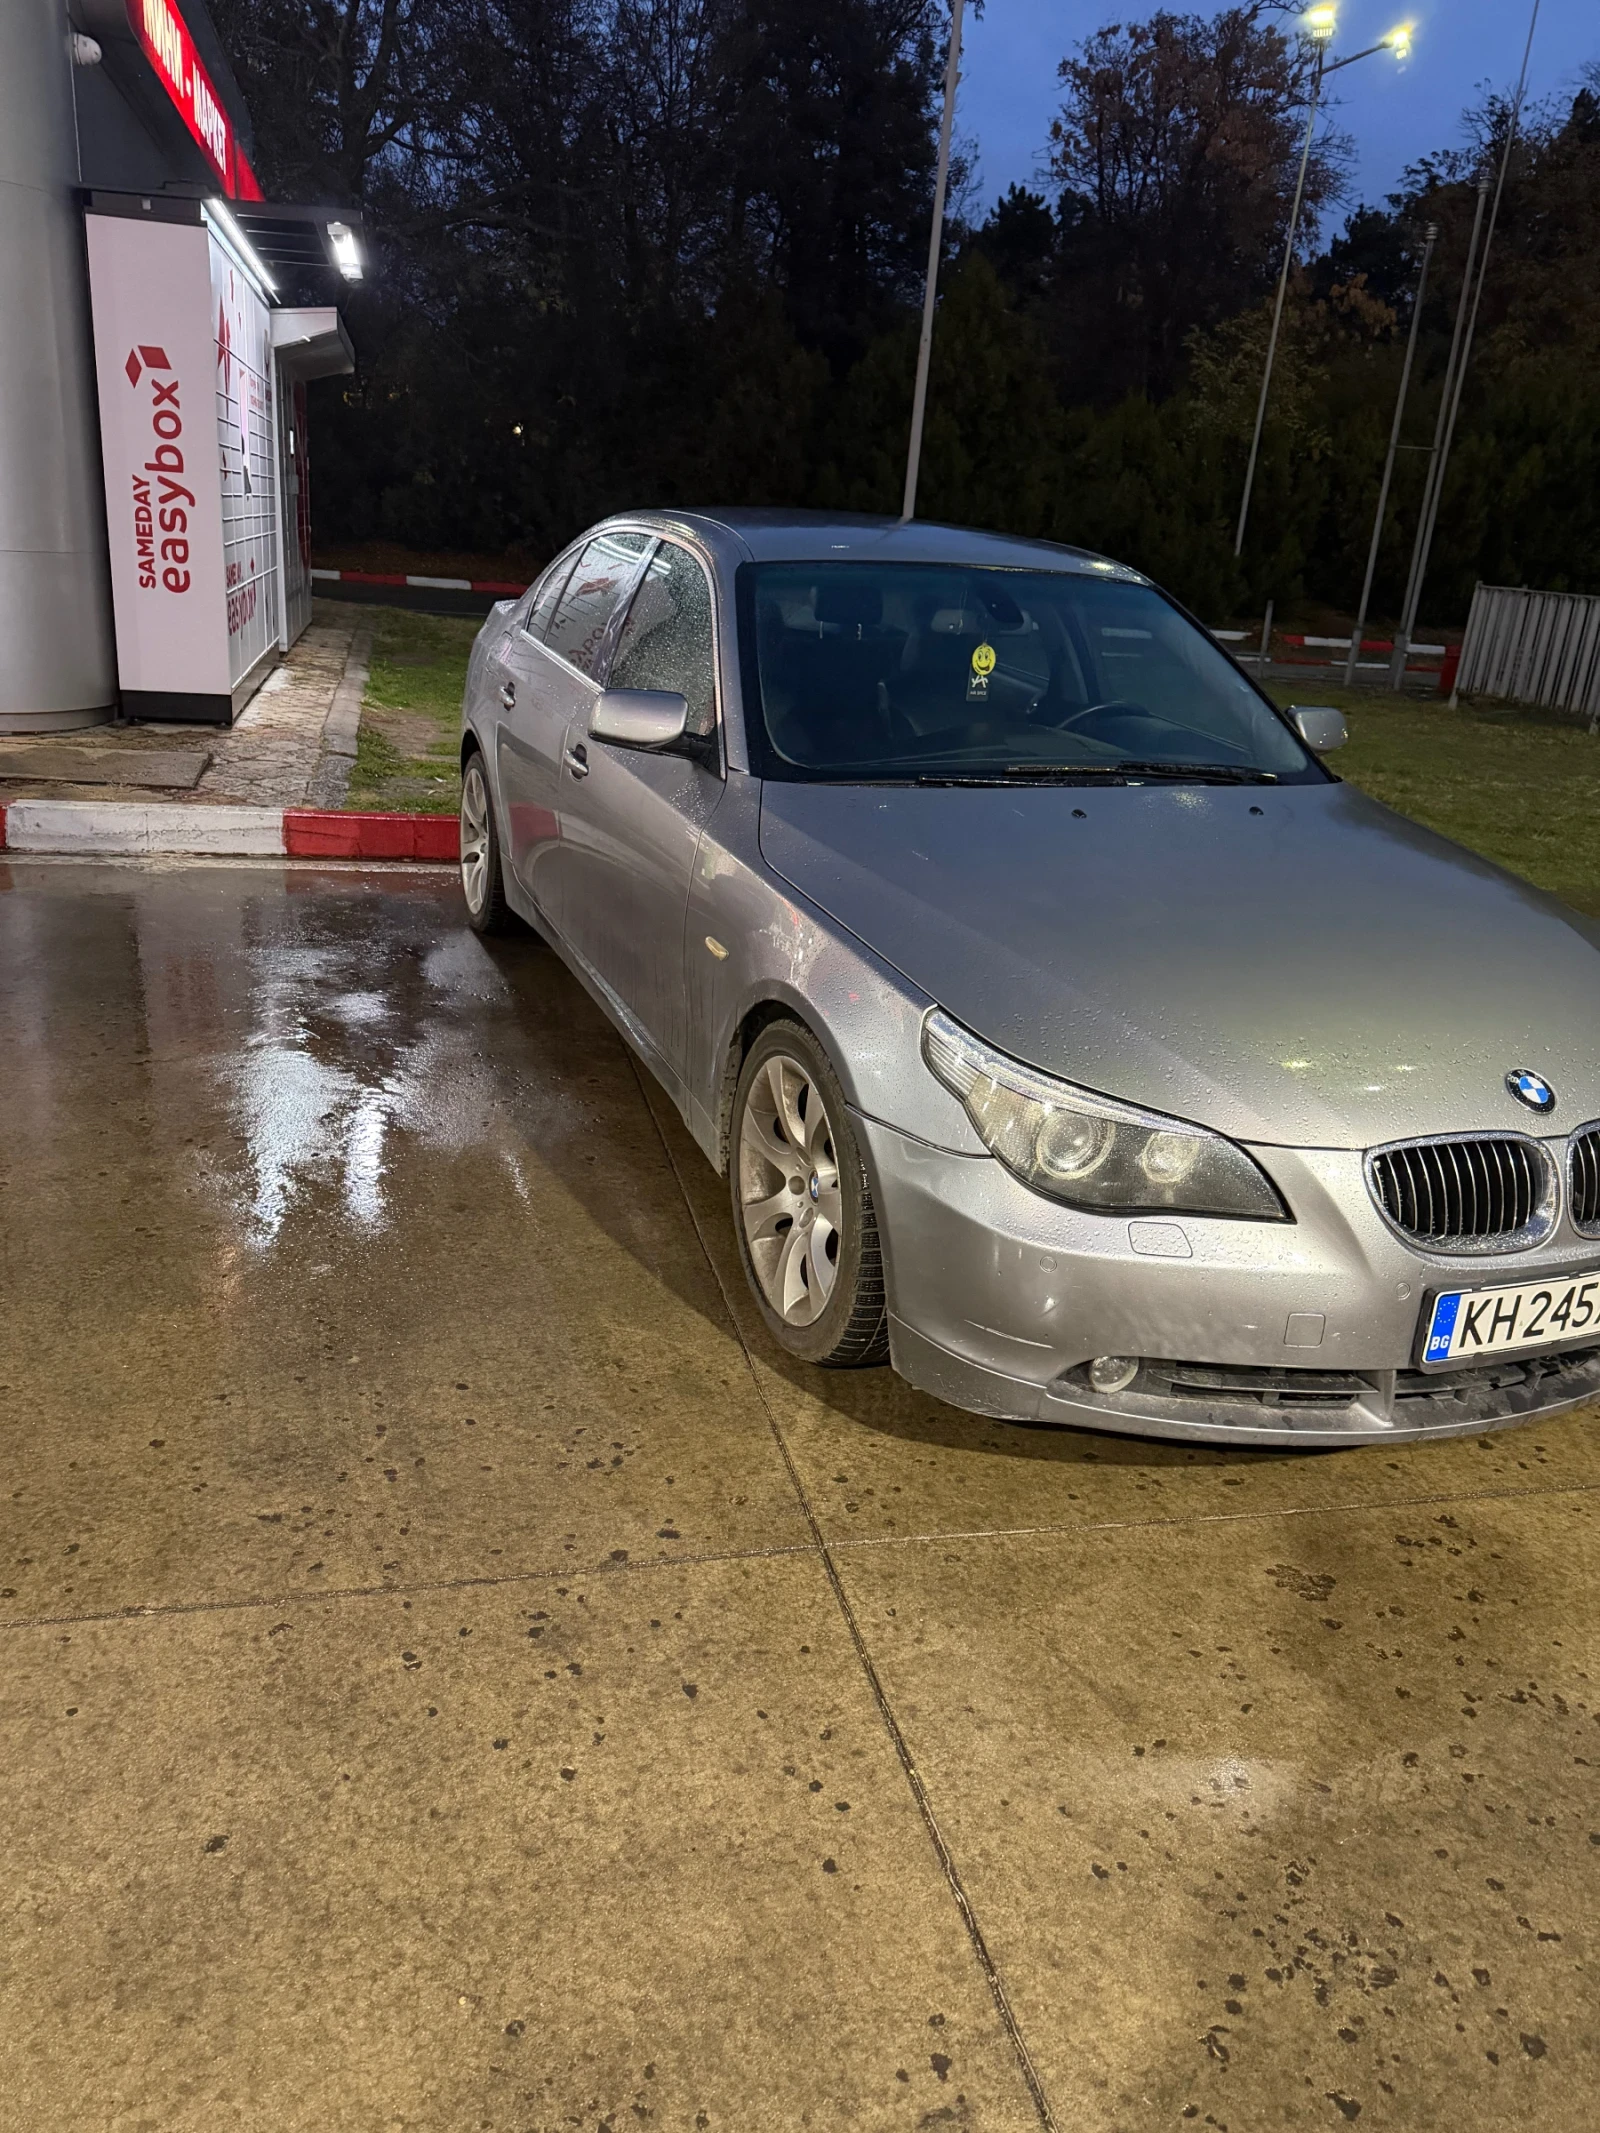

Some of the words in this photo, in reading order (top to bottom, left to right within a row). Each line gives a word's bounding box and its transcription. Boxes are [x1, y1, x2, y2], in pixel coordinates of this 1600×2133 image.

[132, 474, 157, 590] SAMEDAY
[144, 378, 196, 594] easybox
[1430, 1335, 1450, 1350] BG
